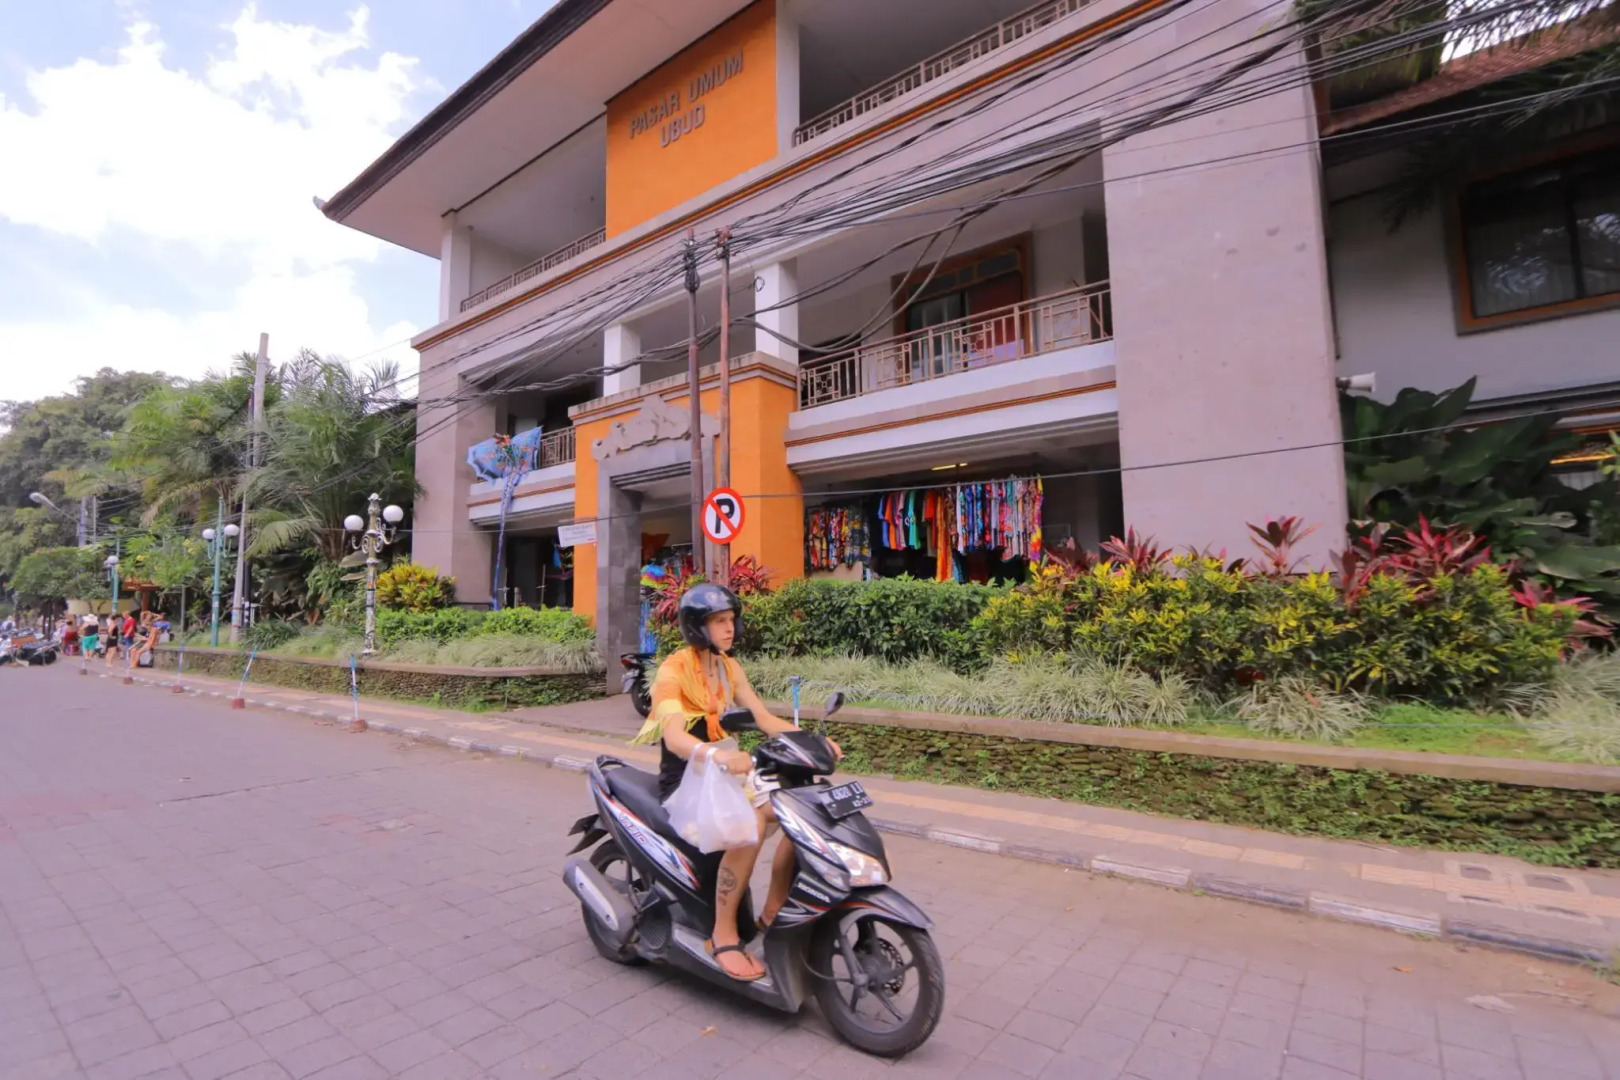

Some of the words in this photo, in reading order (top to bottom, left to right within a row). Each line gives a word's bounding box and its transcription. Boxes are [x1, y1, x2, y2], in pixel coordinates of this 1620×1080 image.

[630, 91, 680, 139] PASAR
[687, 51, 744, 103] UMUM
[660, 105, 706, 148] UBUD
[715, 498, 735, 534] P
[797, 882, 831, 904] HONDA
